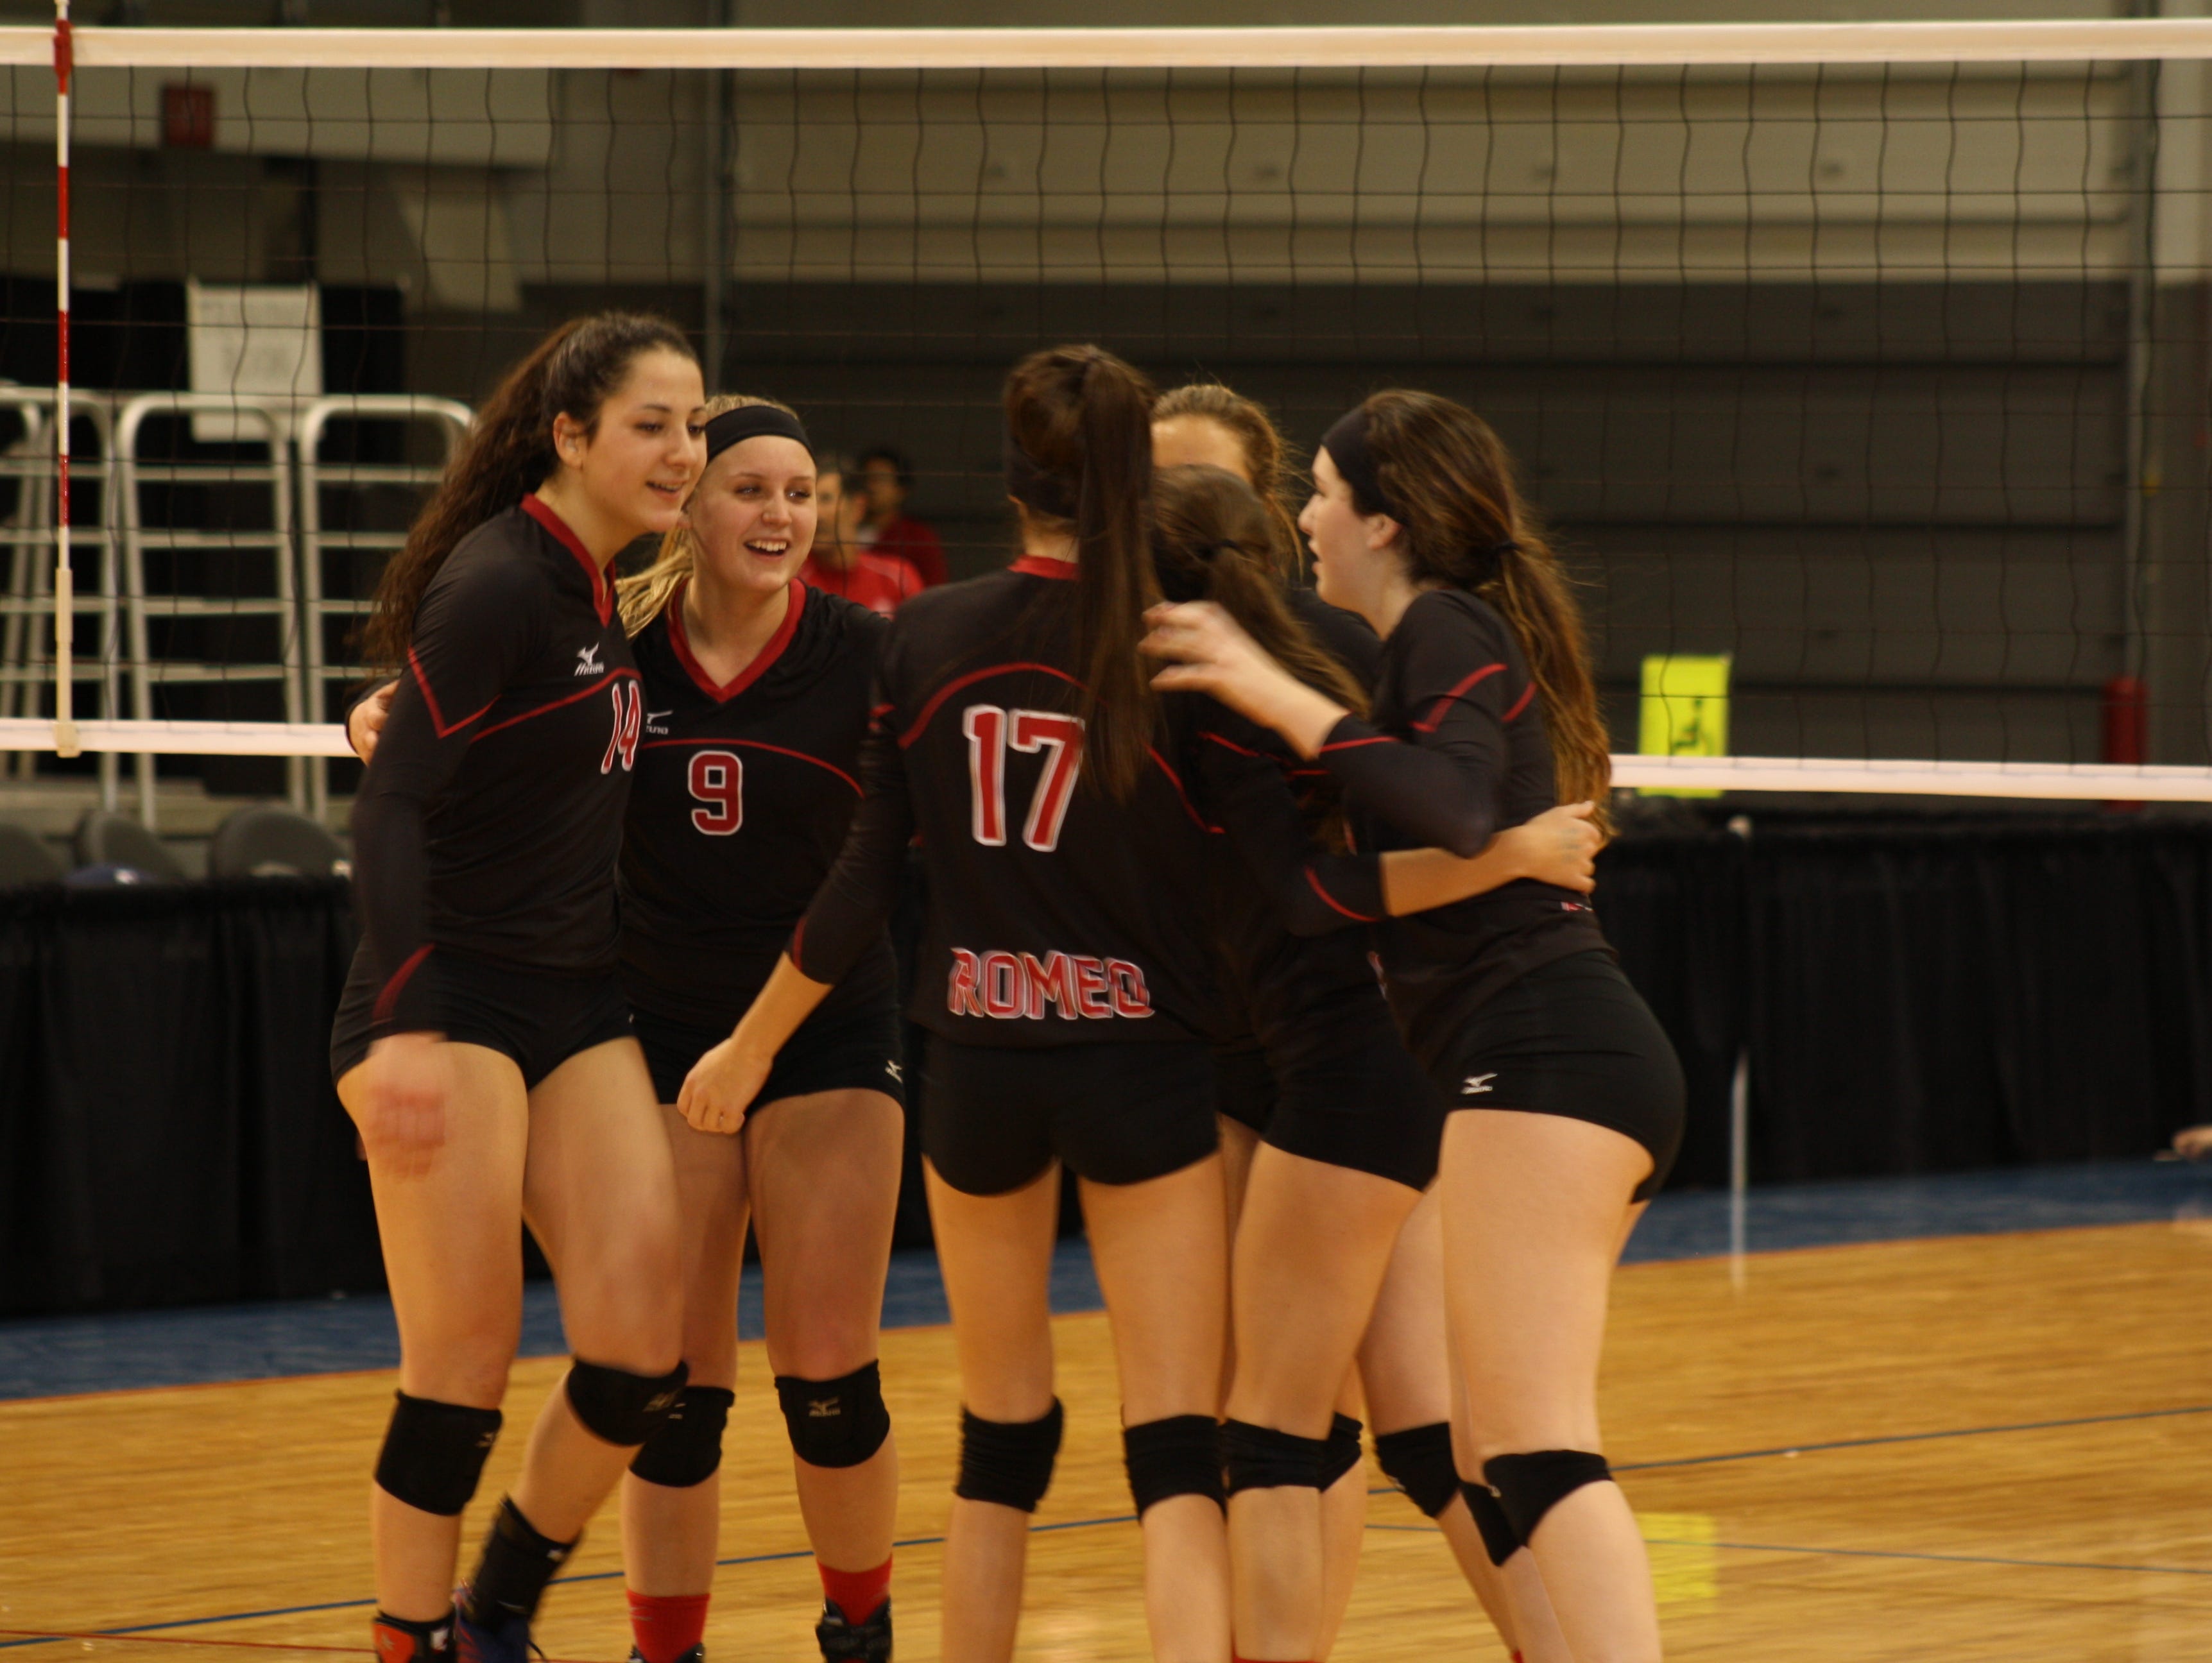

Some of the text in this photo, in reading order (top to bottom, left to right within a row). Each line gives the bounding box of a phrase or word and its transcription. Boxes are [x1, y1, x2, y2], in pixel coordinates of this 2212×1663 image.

[601, 679, 641, 774] 14
[688, 751, 743, 835] 9
[963, 704, 1085, 852] 17
[947, 948, 1155, 1019] ROMEO
